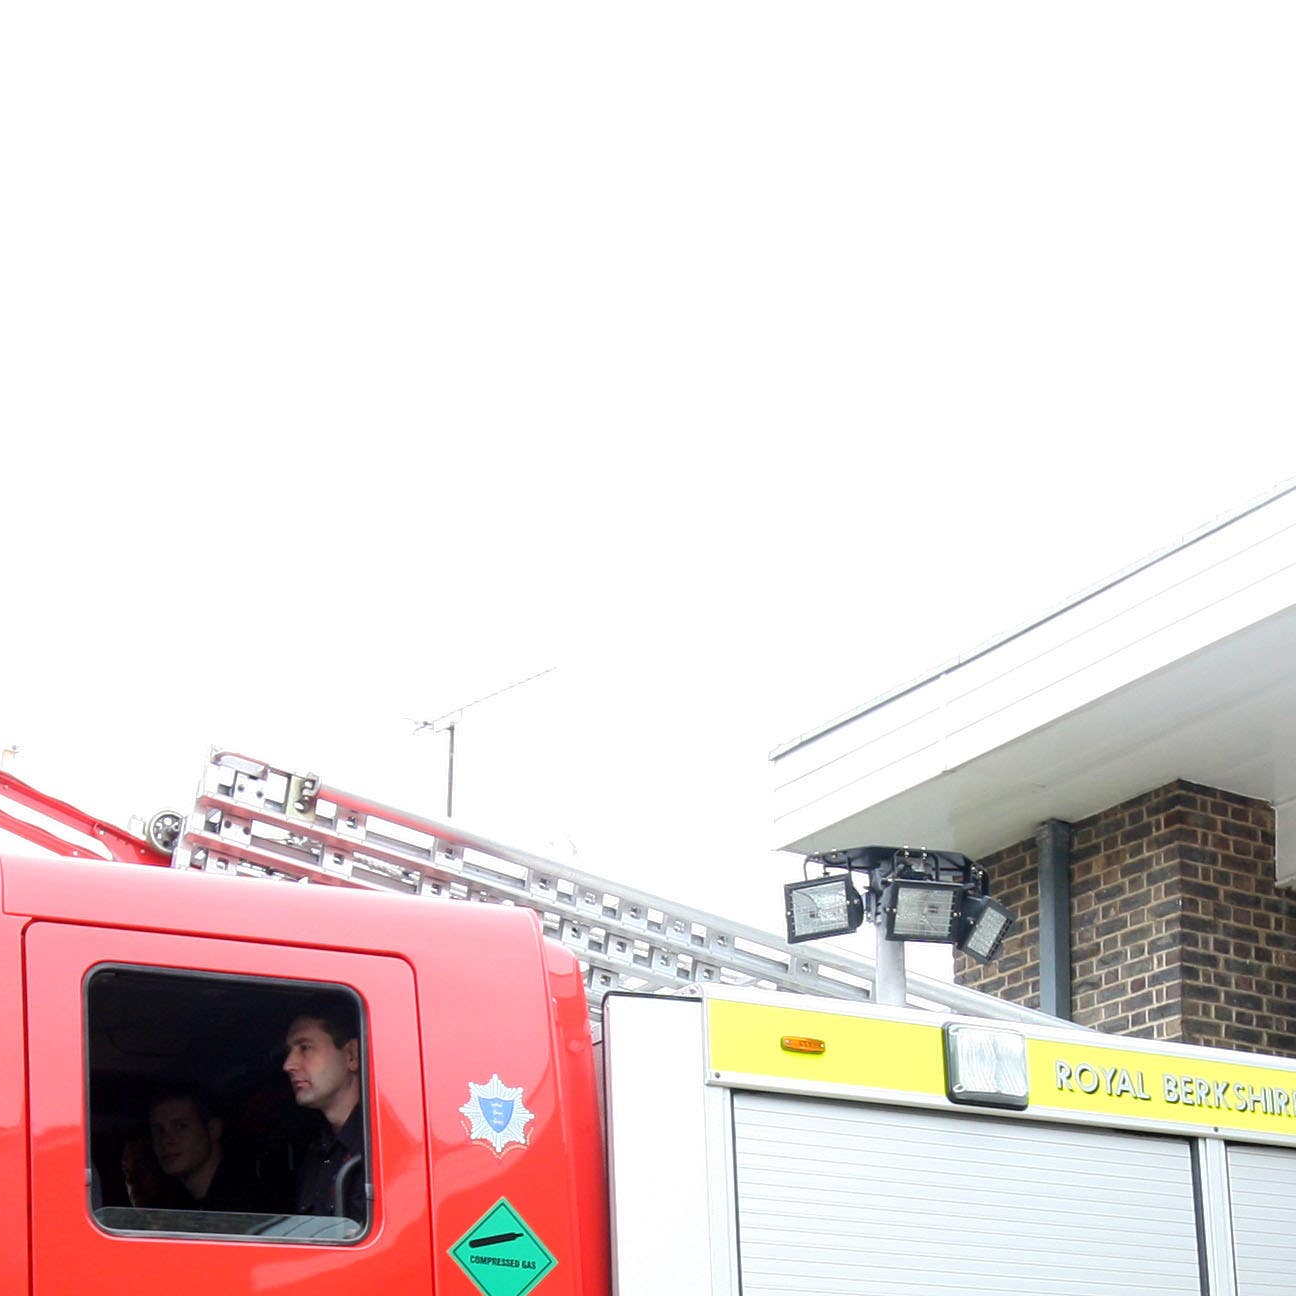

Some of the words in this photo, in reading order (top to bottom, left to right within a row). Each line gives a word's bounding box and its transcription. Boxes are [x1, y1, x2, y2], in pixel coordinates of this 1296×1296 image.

[1055, 1059, 1151, 1101] ROYAL
[470, 1255, 520, 1268] COMPRESSED
[522, 1260, 536, 1270] GAS
